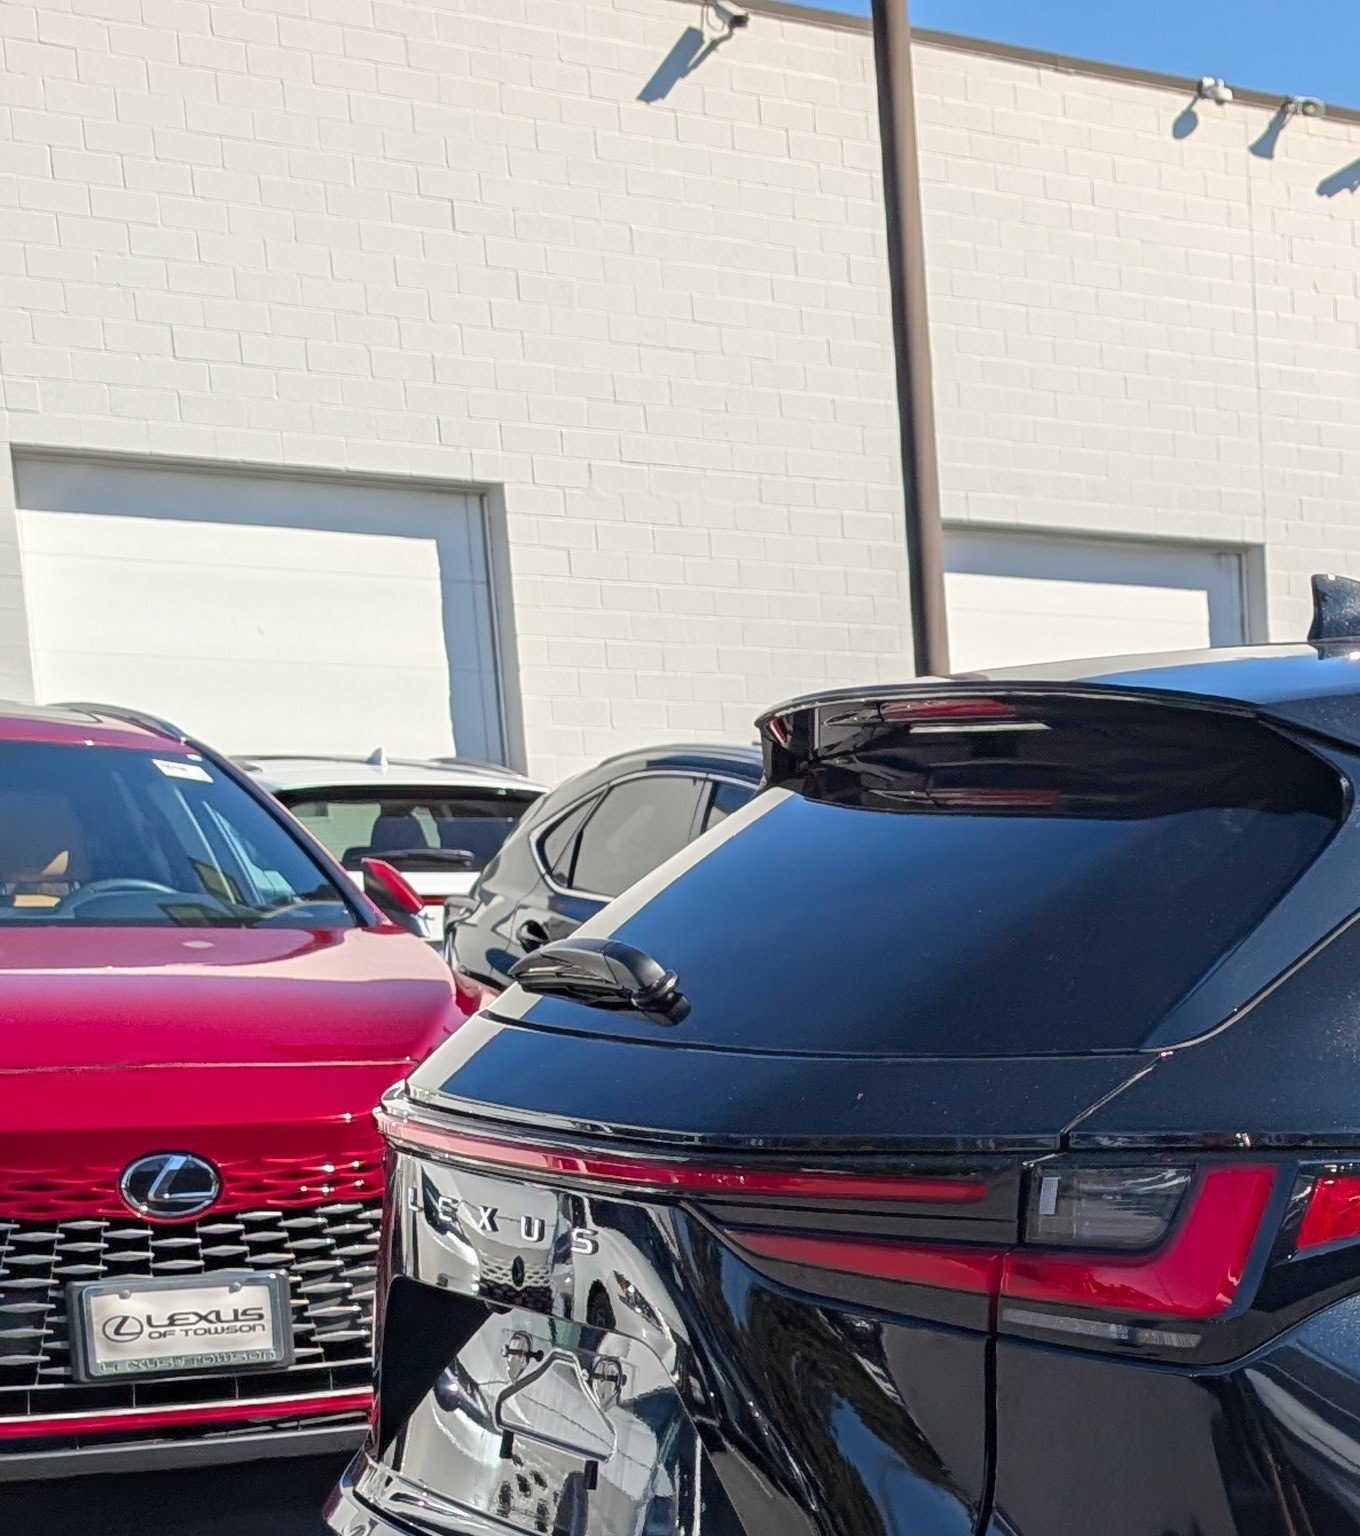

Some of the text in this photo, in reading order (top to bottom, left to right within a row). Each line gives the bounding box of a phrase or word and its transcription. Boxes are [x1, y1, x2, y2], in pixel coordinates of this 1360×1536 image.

[407, 1186, 600, 1256] LEXUS
[147, 1307, 265, 1328] LEXUS
[148, 1323, 266, 1340] OF TOWSON
